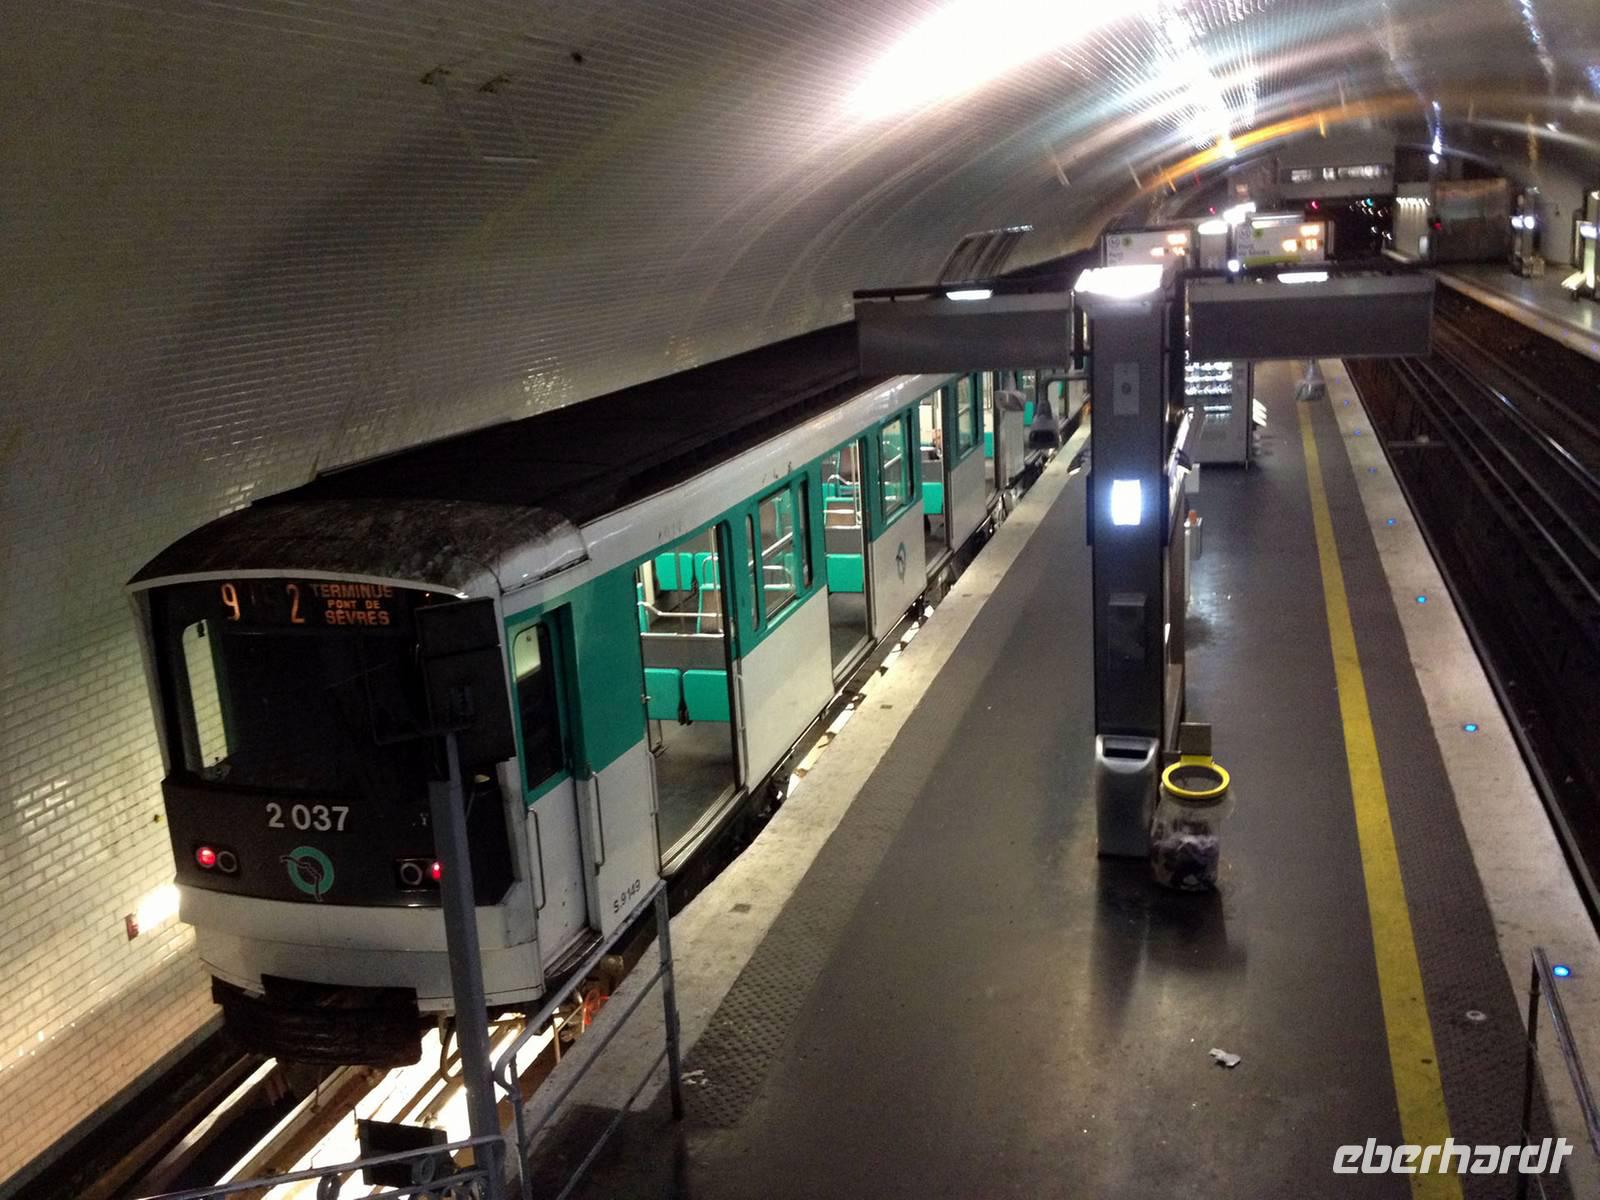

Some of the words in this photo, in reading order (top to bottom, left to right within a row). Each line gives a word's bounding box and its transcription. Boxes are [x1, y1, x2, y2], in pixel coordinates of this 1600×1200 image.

[221, 583, 241, 622] 9
[286, 584, 306, 624] 2
[327, 599, 358, 610] PONT
[365, 599, 382, 610] DE
